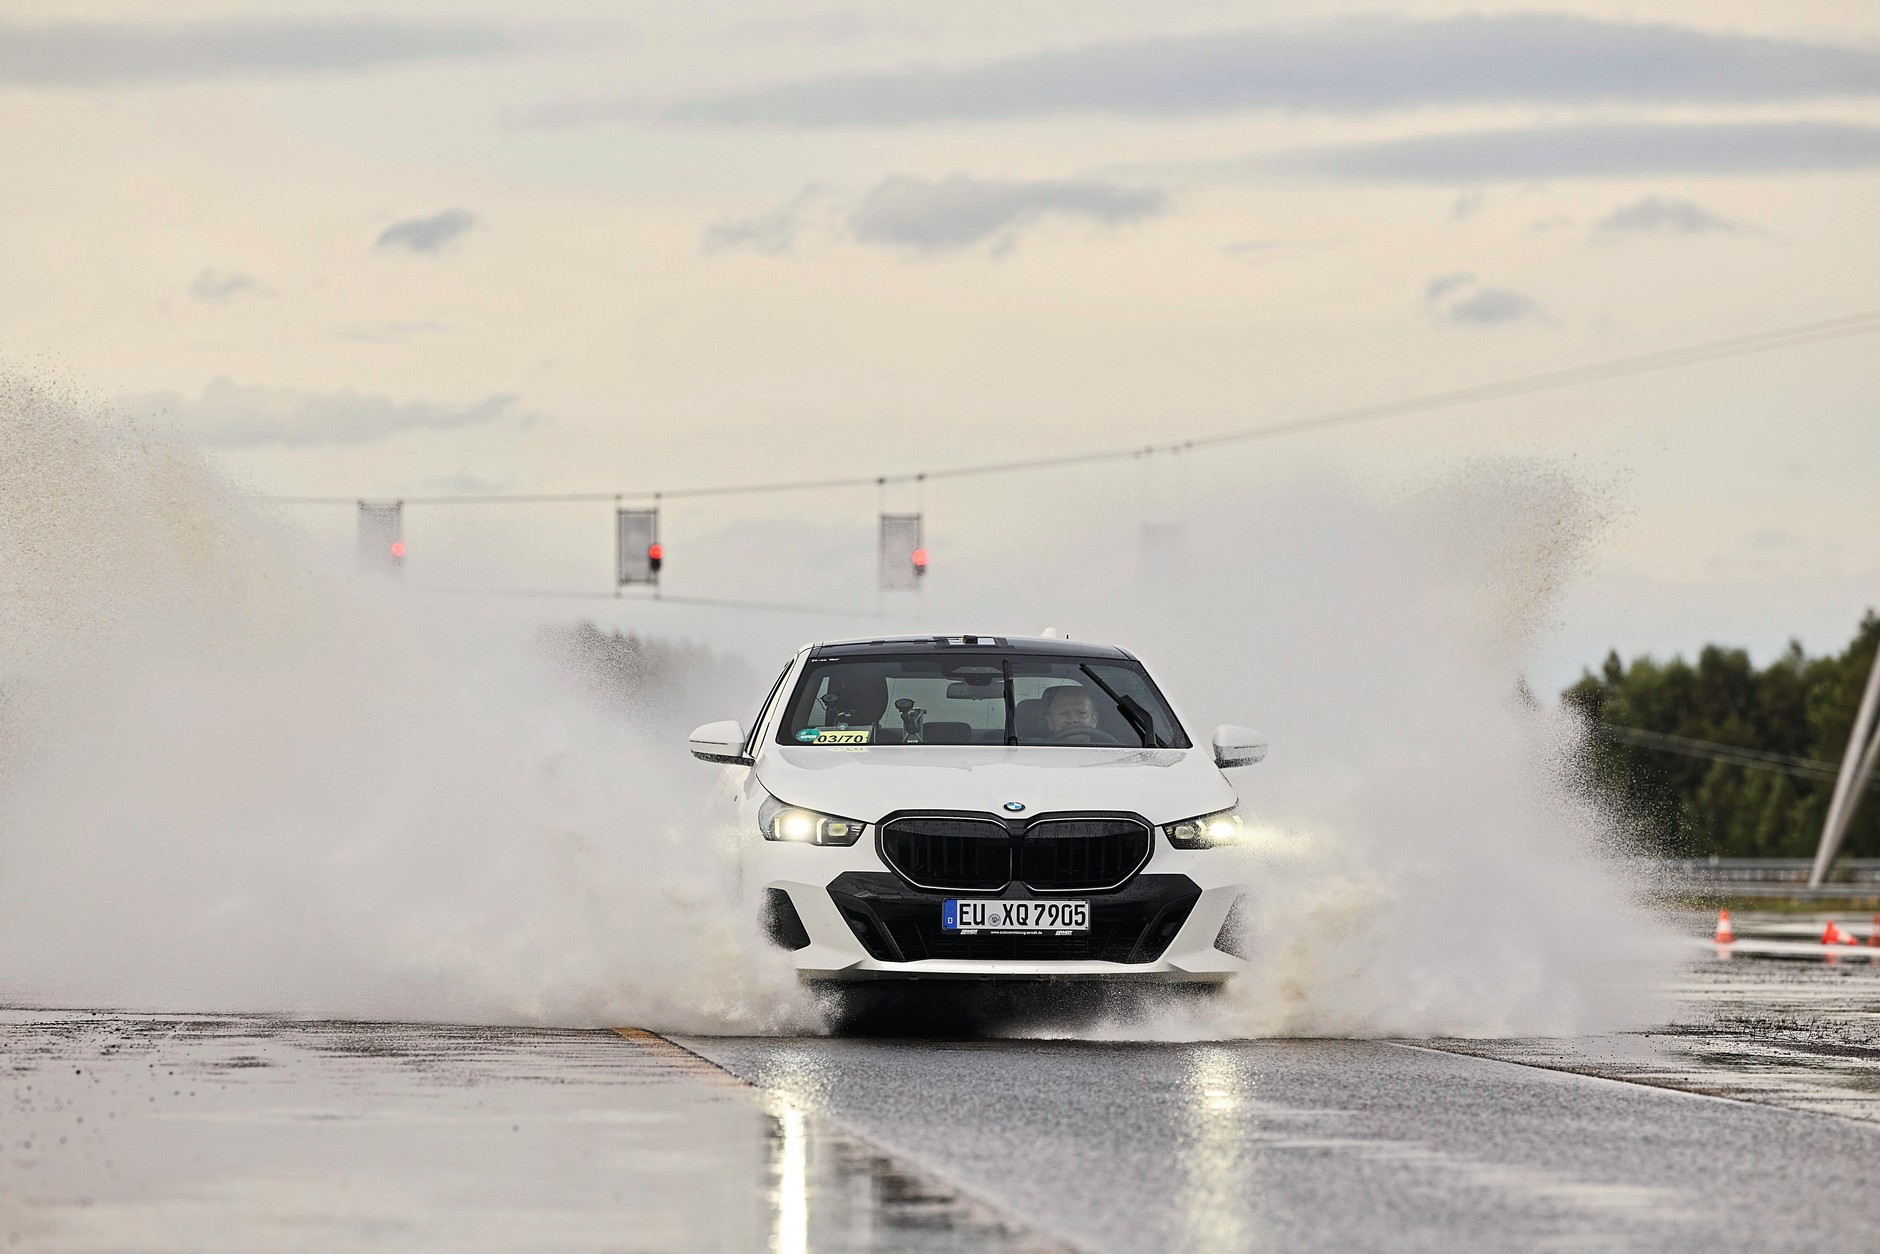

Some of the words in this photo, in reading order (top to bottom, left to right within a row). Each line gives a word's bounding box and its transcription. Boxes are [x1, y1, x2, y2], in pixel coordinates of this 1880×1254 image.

[817, 734, 864, 743] 03/70
[959, 903, 986, 926] EU
[1002, 903, 1029, 926] XQ
[1034, 904, 1086, 926] 7905
